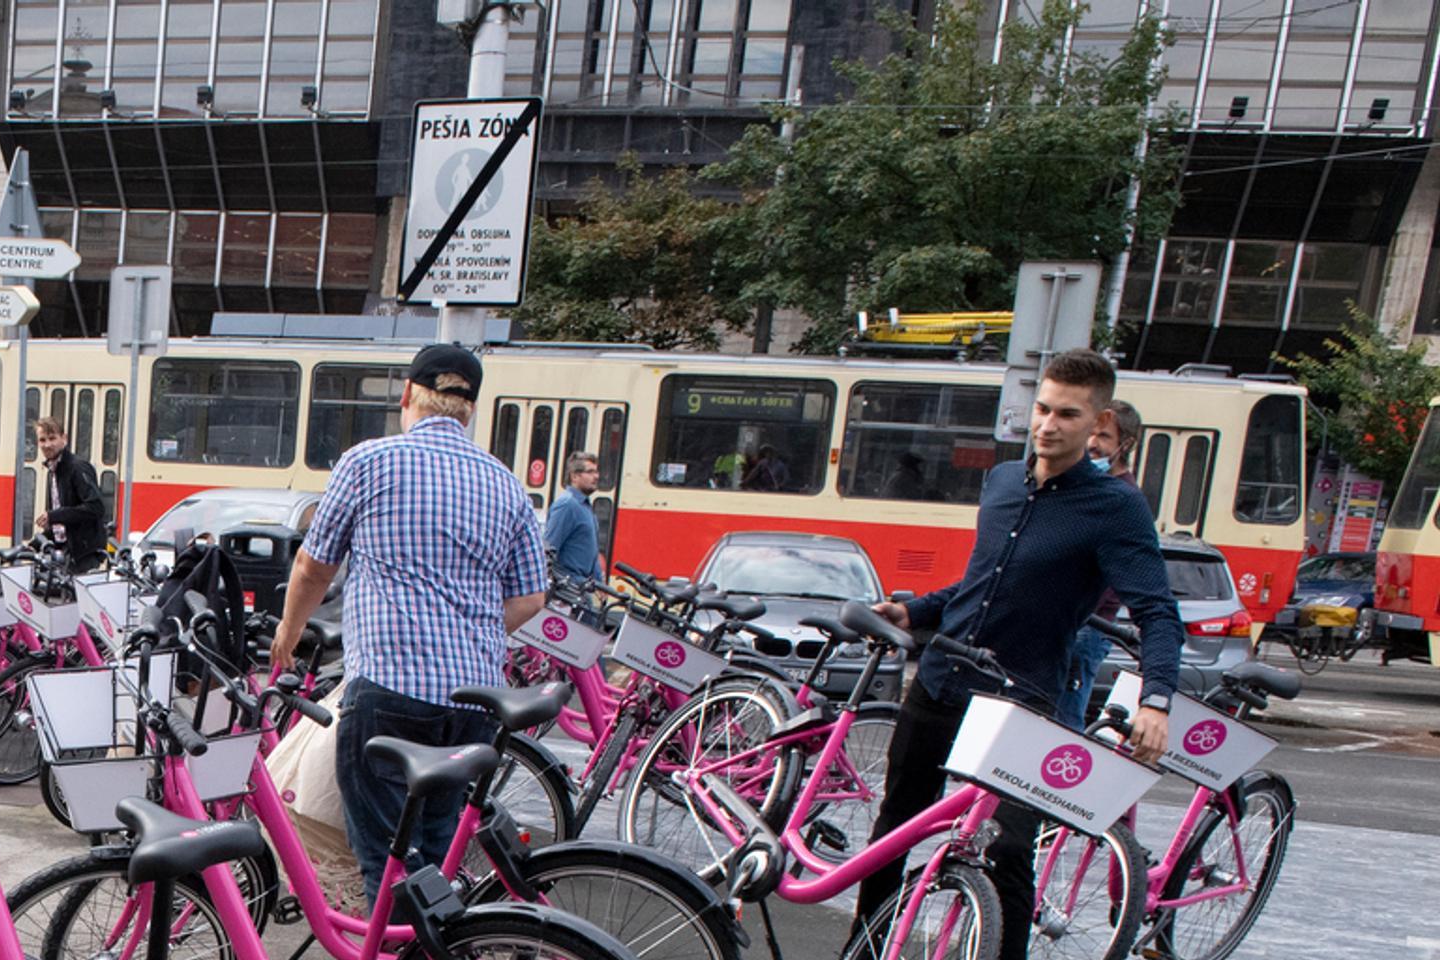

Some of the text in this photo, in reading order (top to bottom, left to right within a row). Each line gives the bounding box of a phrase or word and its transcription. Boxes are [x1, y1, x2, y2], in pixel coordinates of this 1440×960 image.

[420, 114, 471, 139] PEŠIA
[470, 229, 511, 239] OBSLUHA
[0, 245, 56, 257] CENTRUM
[0, 259, 43, 270] CENTRE
[457, 271, 509, 280] BRATISLAVY
[688, 393, 702, 414] 9
[992, 767, 1030, 791] REKOLA
[1031, 785, 1095, 820] BIKESHARING
